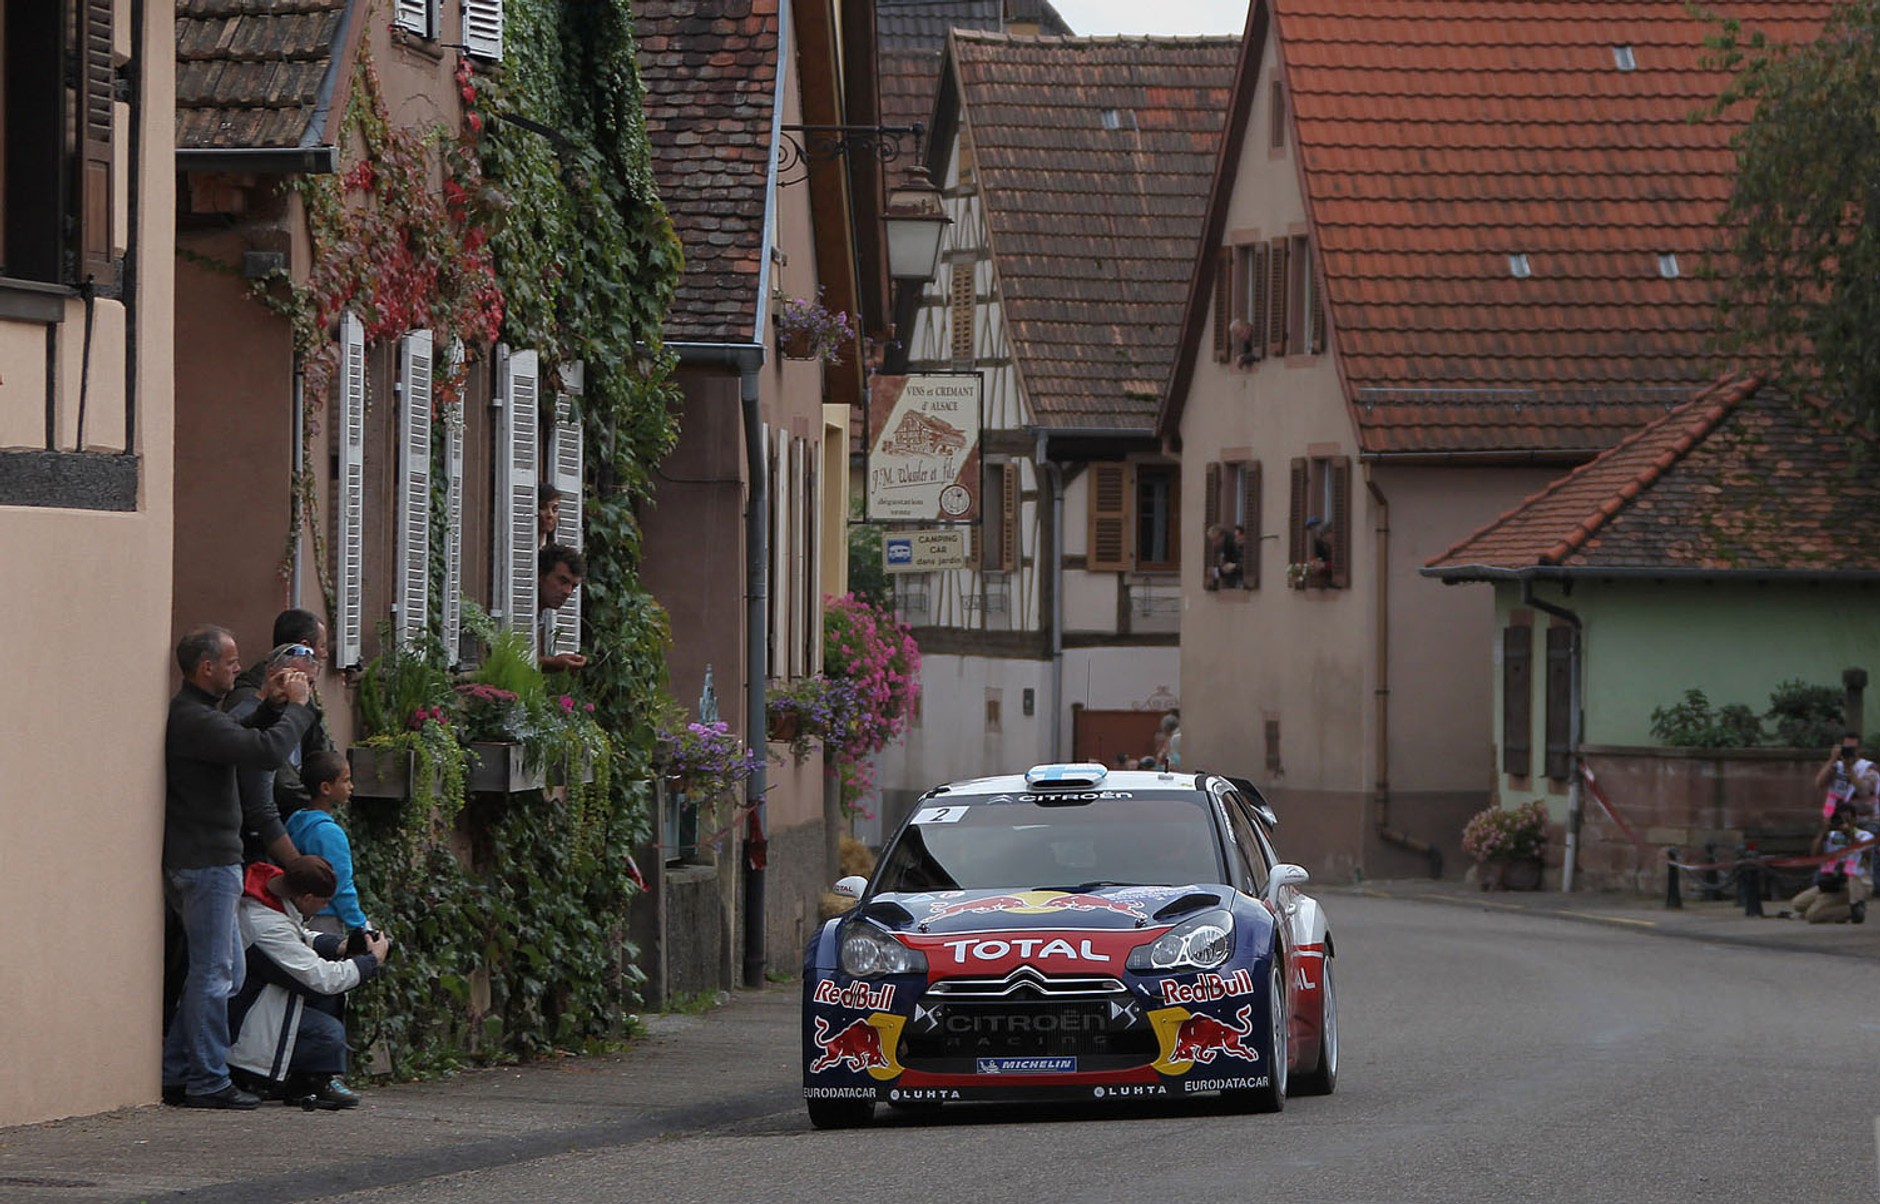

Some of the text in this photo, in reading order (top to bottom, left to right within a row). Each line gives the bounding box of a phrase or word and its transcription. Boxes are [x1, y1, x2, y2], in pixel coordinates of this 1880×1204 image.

[907, 386, 925, 396] VINS
[926, 388, 934, 396] et
[931, 401, 959, 411] ALSACE
[918, 534, 959, 544] CAMPING
[929, 546, 947, 554] CAR
[930, 808, 950, 822] 2
[943, 938, 1111, 964] TOTAL
[1002, 1059, 1072, 1070] MICHELIN
[1184, 1076, 1270, 1092] EURODATACAR
[803, 1087, 877, 1098] EURODATACAR
[903, 1089, 961, 1099] LUHTA
[1108, 1085, 1167, 1096] LUHTA
